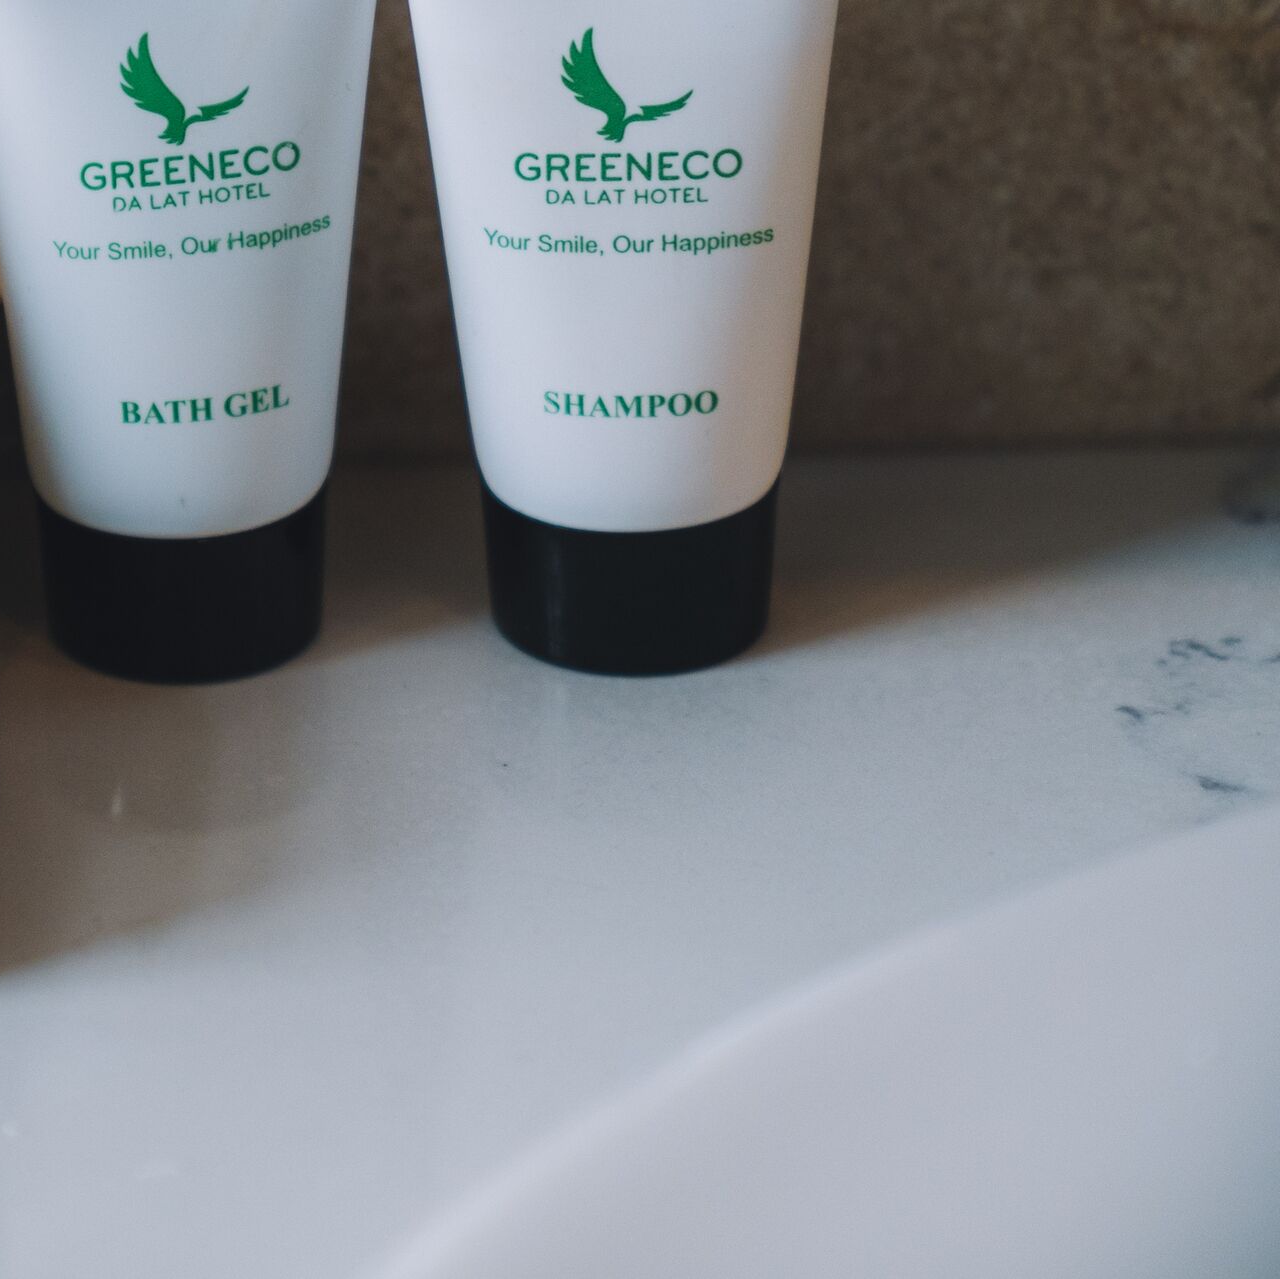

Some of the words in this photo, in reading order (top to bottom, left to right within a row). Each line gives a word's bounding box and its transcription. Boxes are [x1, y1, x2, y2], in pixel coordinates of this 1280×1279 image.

[80, 141, 301, 191] GREENECO
[514, 148, 743, 183] GREENECO
[112, 195, 142, 212] DA
[150, 191, 190, 210] LAT
[199, 182, 270, 205] HOTEL
[545, 189, 576, 205] DA
[584, 188, 626, 205] LAT
[635, 187, 708, 205] HOTEL
[53, 240, 100, 260] Your
[108, 241, 173, 261] Smile,
[181, 236, 219, 255] Our
[227, 215, 331, 251] Happiness
[484, 227, 530, 251] Your
[538, 234, 604, 257] Smile,
[613, 234, 654, 255] Our
[661, 227, 774, 255] Happiness
[121, 397, 213, 425] BATH
[223, 384, 290, 419] GEL
[543, 390, 719, 418] SHAMPOO
